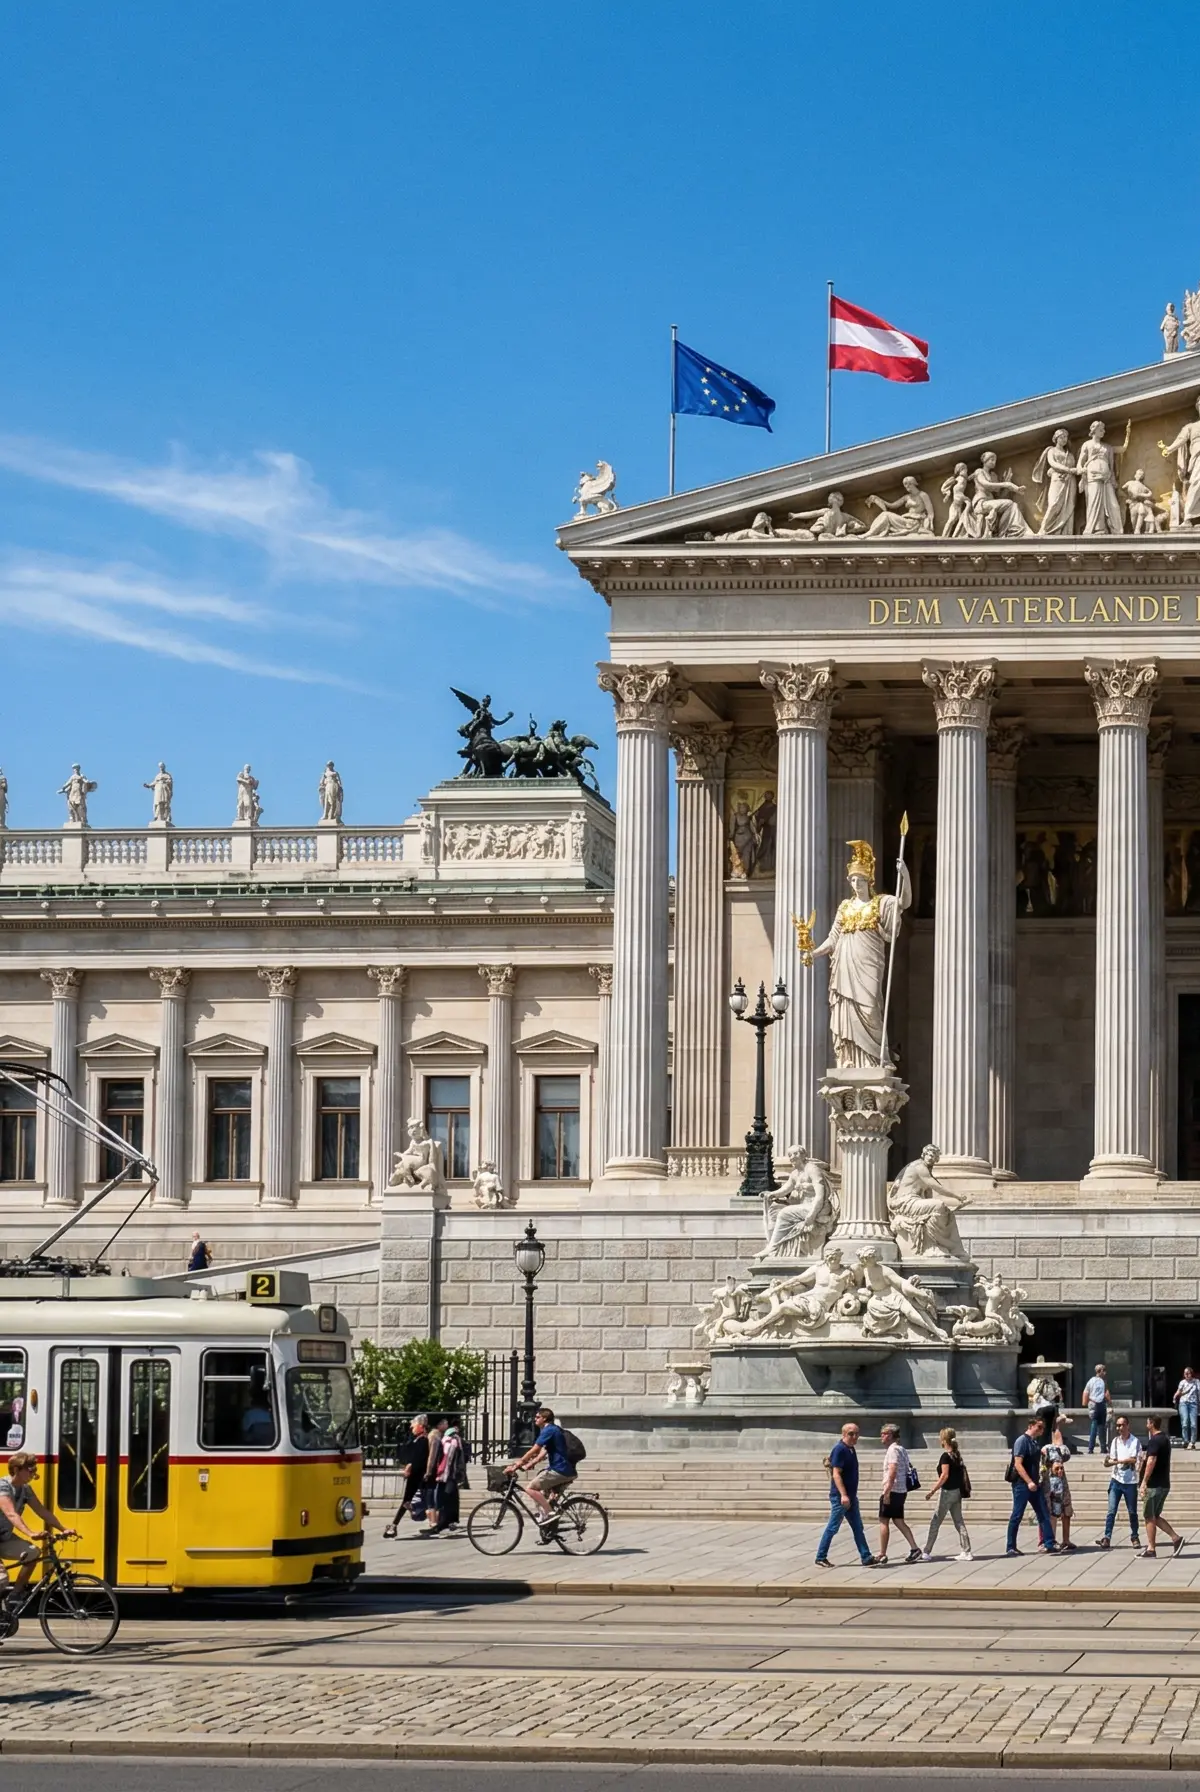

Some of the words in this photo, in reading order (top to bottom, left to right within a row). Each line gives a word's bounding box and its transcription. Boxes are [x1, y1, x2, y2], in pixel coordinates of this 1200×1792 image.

[868, 598, 942, 625] DEM
[957, 596, 1182, 624] VATERLANDE
[256, 1276, 270, 1295] 2
